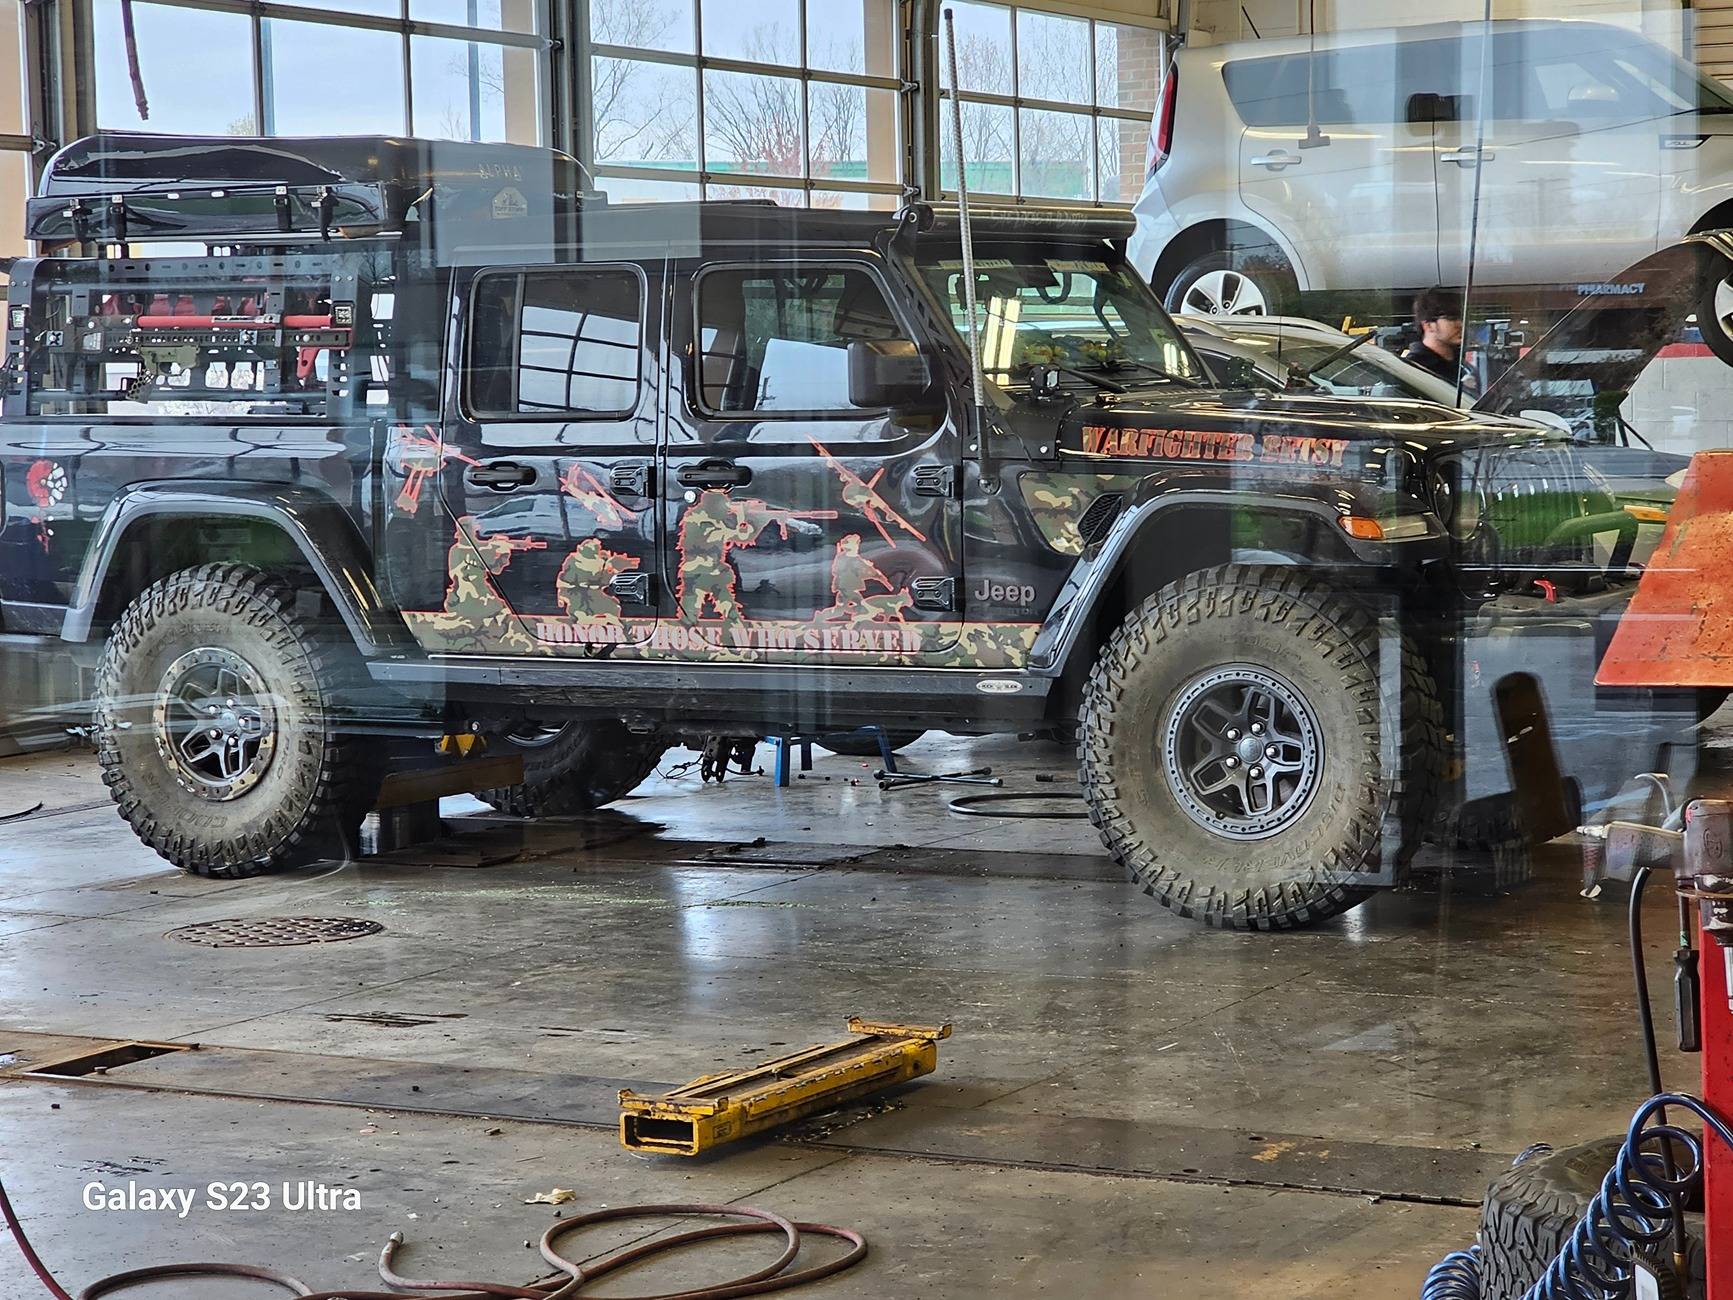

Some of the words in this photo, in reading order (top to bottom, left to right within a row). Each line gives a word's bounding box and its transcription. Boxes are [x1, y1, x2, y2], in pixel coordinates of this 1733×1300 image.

[1577, 283, 1646, 295] PHARMACY
[1082, 427, 1255, 461] WARFIGHTER
[1260, 434, 1350, 466] BETSY
[974, 579, 1035, 606] Jeep
[537, 622, 627, 647] HONOR
[629, 625, 723, 651] THOSE
[729, 627, 797, 652] WHO
[803, 628, 923, 655] SERVED
